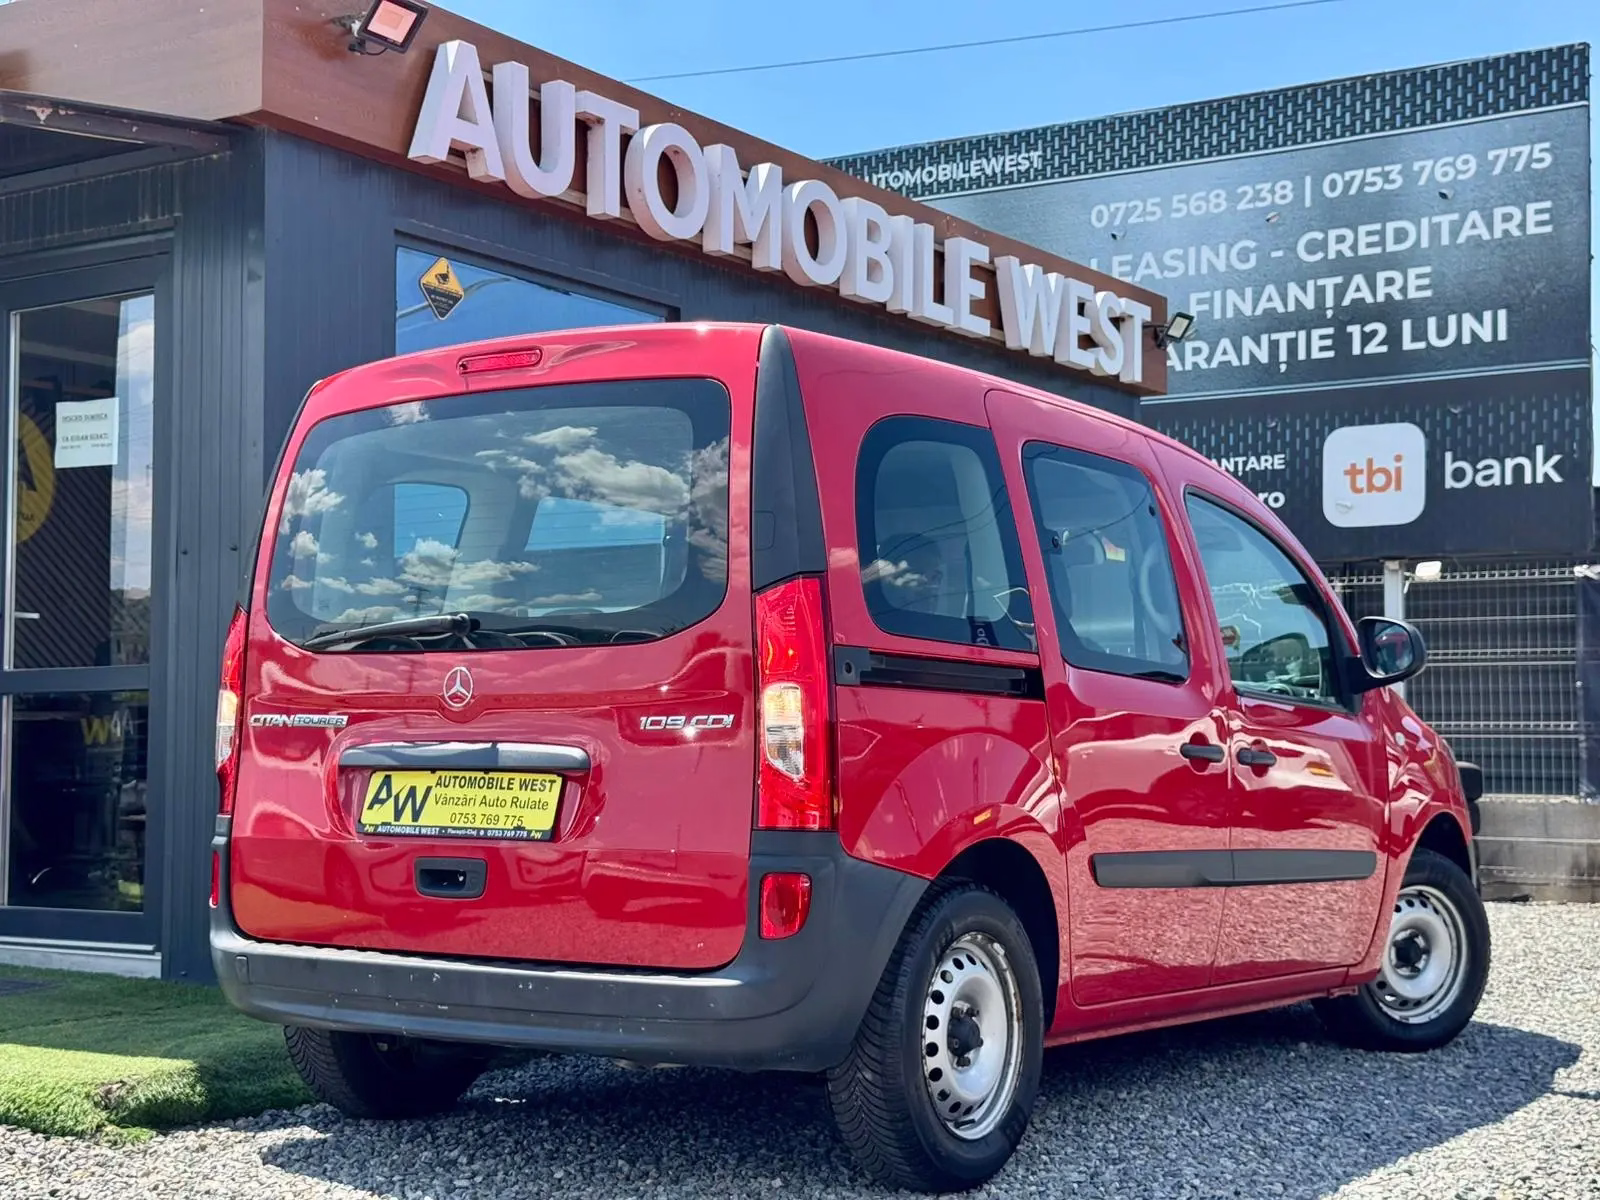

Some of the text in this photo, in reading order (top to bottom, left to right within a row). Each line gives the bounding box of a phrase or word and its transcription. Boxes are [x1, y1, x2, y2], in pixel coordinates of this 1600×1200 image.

[1091, 197, 1162, 228] 0725
[1171, 189, 1227, 218] 568
[1237, 180, 1293, 211] 238
[1323, 164, 1403, 198] 0753
[1413, 154, 1477, 186] 769
[1488, 142, 1552, 176] 775
[408, 39, 1151, 383] AUTOMOBILE WEST
[1296, 201, 1553, 262] CREDITARE
[1189, 266, 1433, 321] FINANȚARE
[1346, 322, 1388, 356] 12
[1402, 309, 1507, 350] LUNI
[1344, 454, 1403, 494] tbi
[1445, 444, 1563, 489] bank
[295, 714, 347, 727] TOURER
[640, 714, 734, 730] 109 CDI
[367, 774, 432, 823] AW
[435, 775, 556, 793] AUTOMOBILE WEST
[478, 797, 506, 808] Auto
[510, 796, 549, 811] Rulate
[377, 825, 419, 834] AUTOMOBILE
[420, 827, 439, 835] WEST
[450, 812, 524, 827] 0753 769 775
